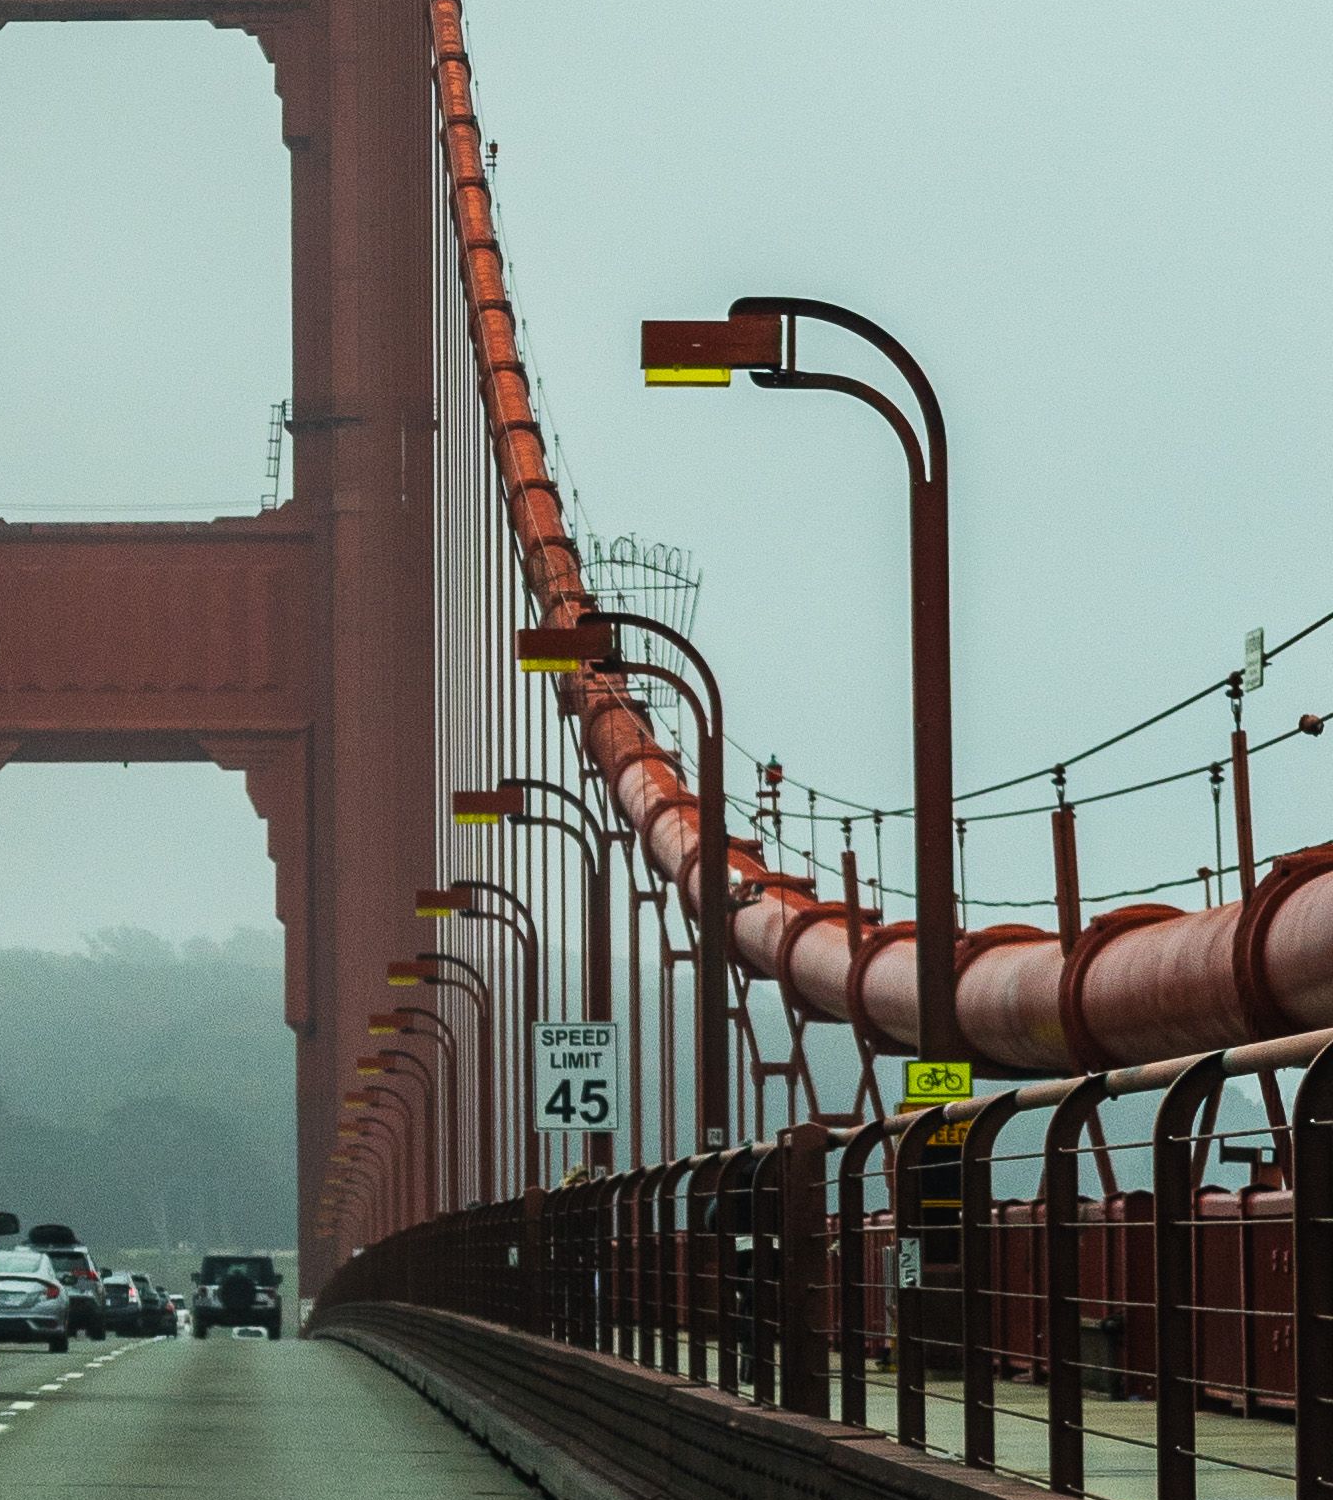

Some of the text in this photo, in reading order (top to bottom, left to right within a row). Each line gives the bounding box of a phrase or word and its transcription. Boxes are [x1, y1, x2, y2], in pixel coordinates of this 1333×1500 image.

[541, 1029, 610, 1046] SPEED
[550, 1053, 602, 1069] LIMIT
[544, 1079, 609, 1124] 45
